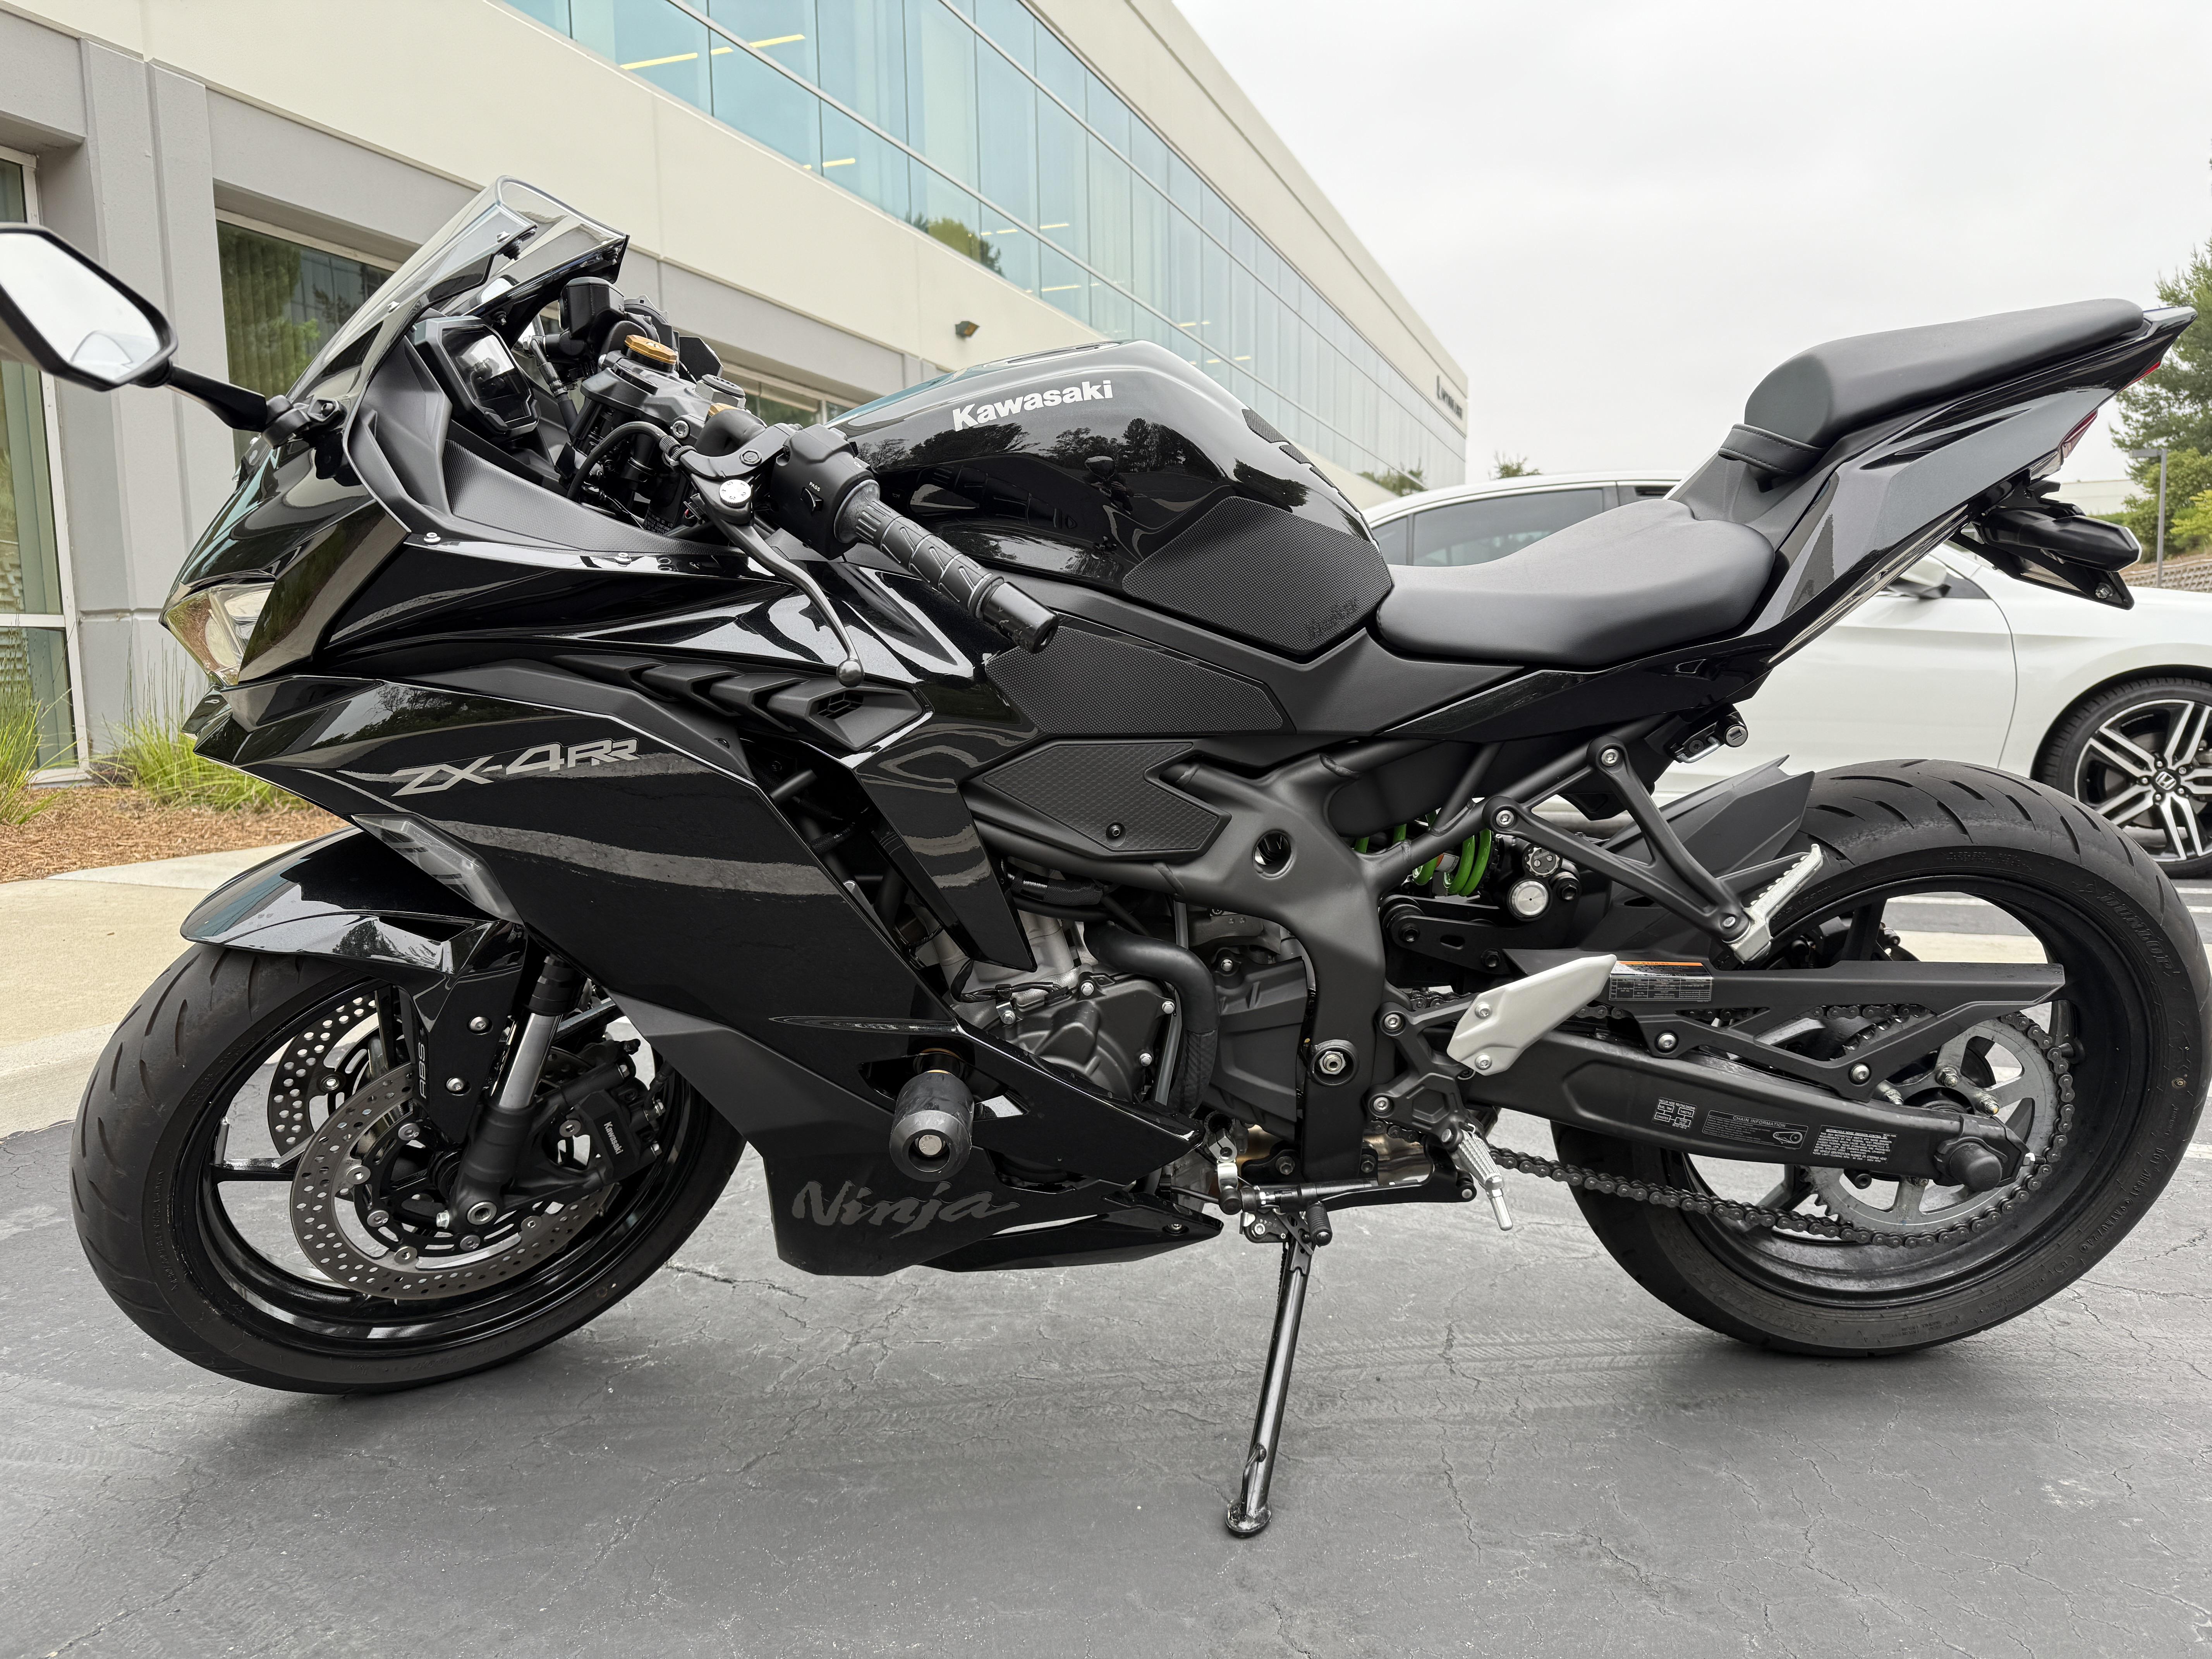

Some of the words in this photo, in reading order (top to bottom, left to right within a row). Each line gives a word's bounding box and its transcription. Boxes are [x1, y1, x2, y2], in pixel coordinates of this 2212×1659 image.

[952, 380, 1113, 432] Kawasaki
[809, 482, 820, 491] PASS
[418, 1042, 426, 1099] ABS
[604, 1121, 623, 1155] Kawasaki
[1750, 1118, 1786, 1128] INFORMATION
[792, 1180, 1020, 1239] Ninja
